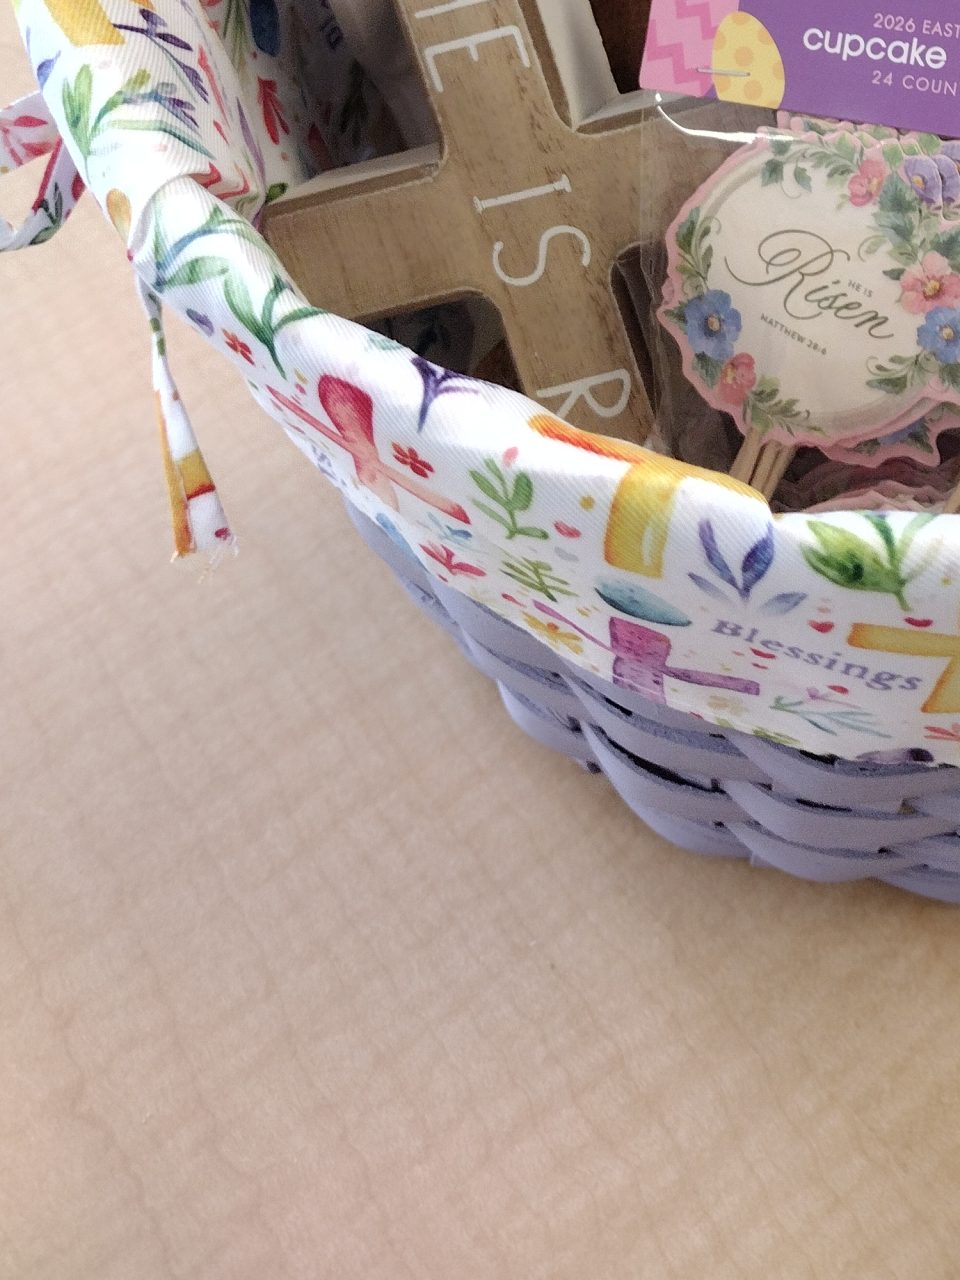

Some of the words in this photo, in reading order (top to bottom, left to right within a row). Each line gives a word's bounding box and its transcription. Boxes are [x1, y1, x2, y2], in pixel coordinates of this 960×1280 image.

[873, 13, 915, 33] 2026
[803, 28, 947, 69] cupcake
[871, 70, 893, 86] 24
[473, 173, 591, 287] IS
[724, 229, 894, 339] Risen
[761, 313, 806, 345] MATTHEW
[711, 620, 923, 691] Blessings
